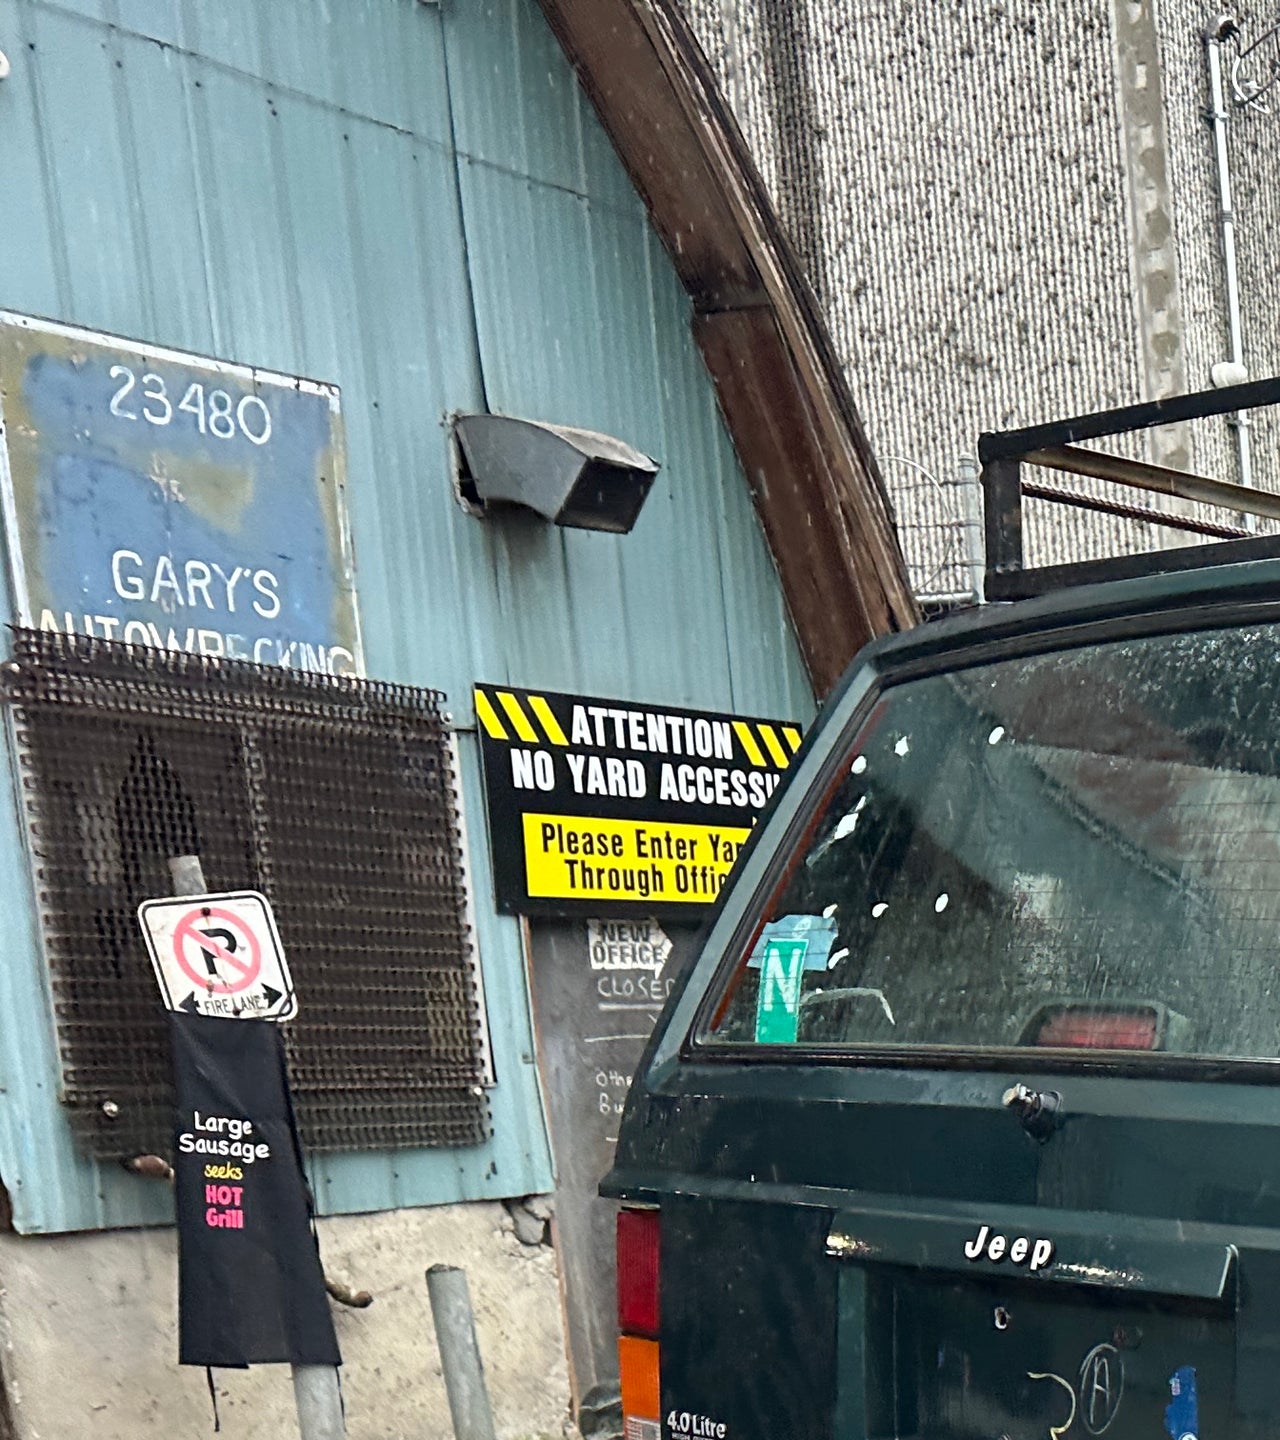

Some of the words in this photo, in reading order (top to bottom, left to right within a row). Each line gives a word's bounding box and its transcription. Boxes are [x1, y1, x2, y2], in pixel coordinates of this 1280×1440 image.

[109, 365, 272, 445] 23480
[111, 549, 281, 619] GARY'S
[571, 705, 733, 760] ATTENTION
[510, 748, 555, 791] NO
[566, 754, 646, 798] YARD
[541, 823, 623, 857] Please
[636, 830, 698, 862] Enter
[708, 834, 744, 863] Yar
[565, 860, 664, 897] Through
[675, 864, 728, 895] Offic
[600, 924, 650, 943] NEW
[592, 942, 667, 965] OFFICE
[763, 948, 803, 1013] N
[204, 998, 232, 1014] FIRE
[232, 995, 265, 1013] LANE
[194, 1110, 253, 1141] Large
[179, 1133, 271, 1164] Sausage
[204, 1161, 244, 1181] seeks
[205, 1184, 244, 1207] HOT
[205, 1207, 245, 1229] Grill
[964, 1226, 1054, 1271] Jeep
[667, 1410, 691, 1433] 4.0
[692, 1414, 728, 1439] Litre
